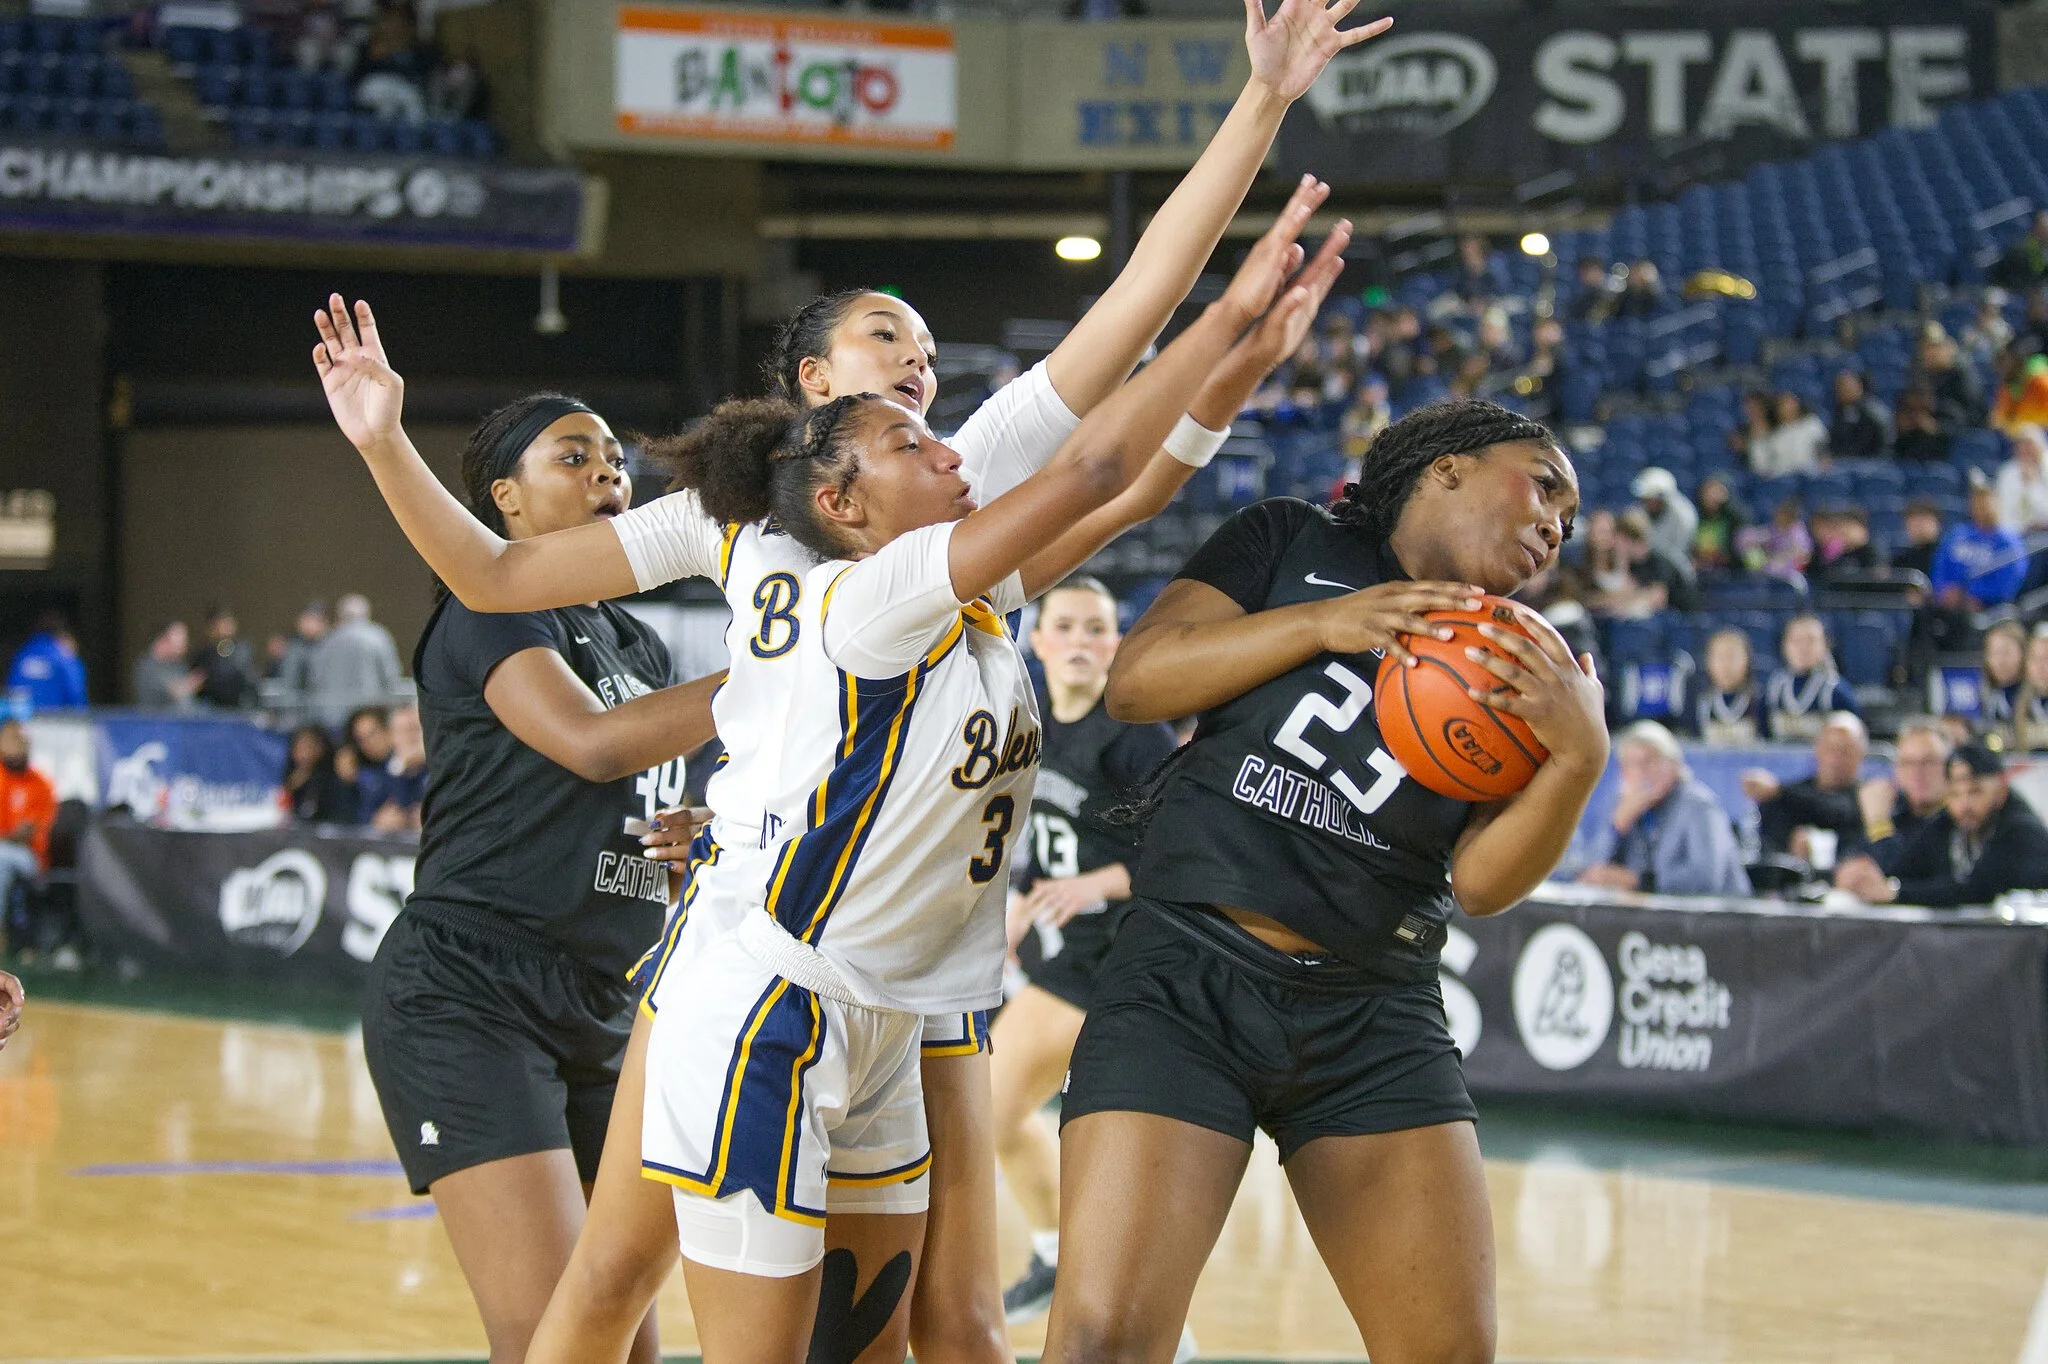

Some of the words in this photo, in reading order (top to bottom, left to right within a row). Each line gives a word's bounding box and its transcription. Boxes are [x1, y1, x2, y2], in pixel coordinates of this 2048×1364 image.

[1531, 27, 1972, 145] STATE
[0, 148, 402, 217] CHAMPIONSHIPS
[751, 571, 802, 661] B
[968, 792, 1015, 885] 3
[1617, 930, 1708, 984] Gesa
[1618, 976, 1733, 1029] Credit
[1617, 1023, 1714, 1072] Union
